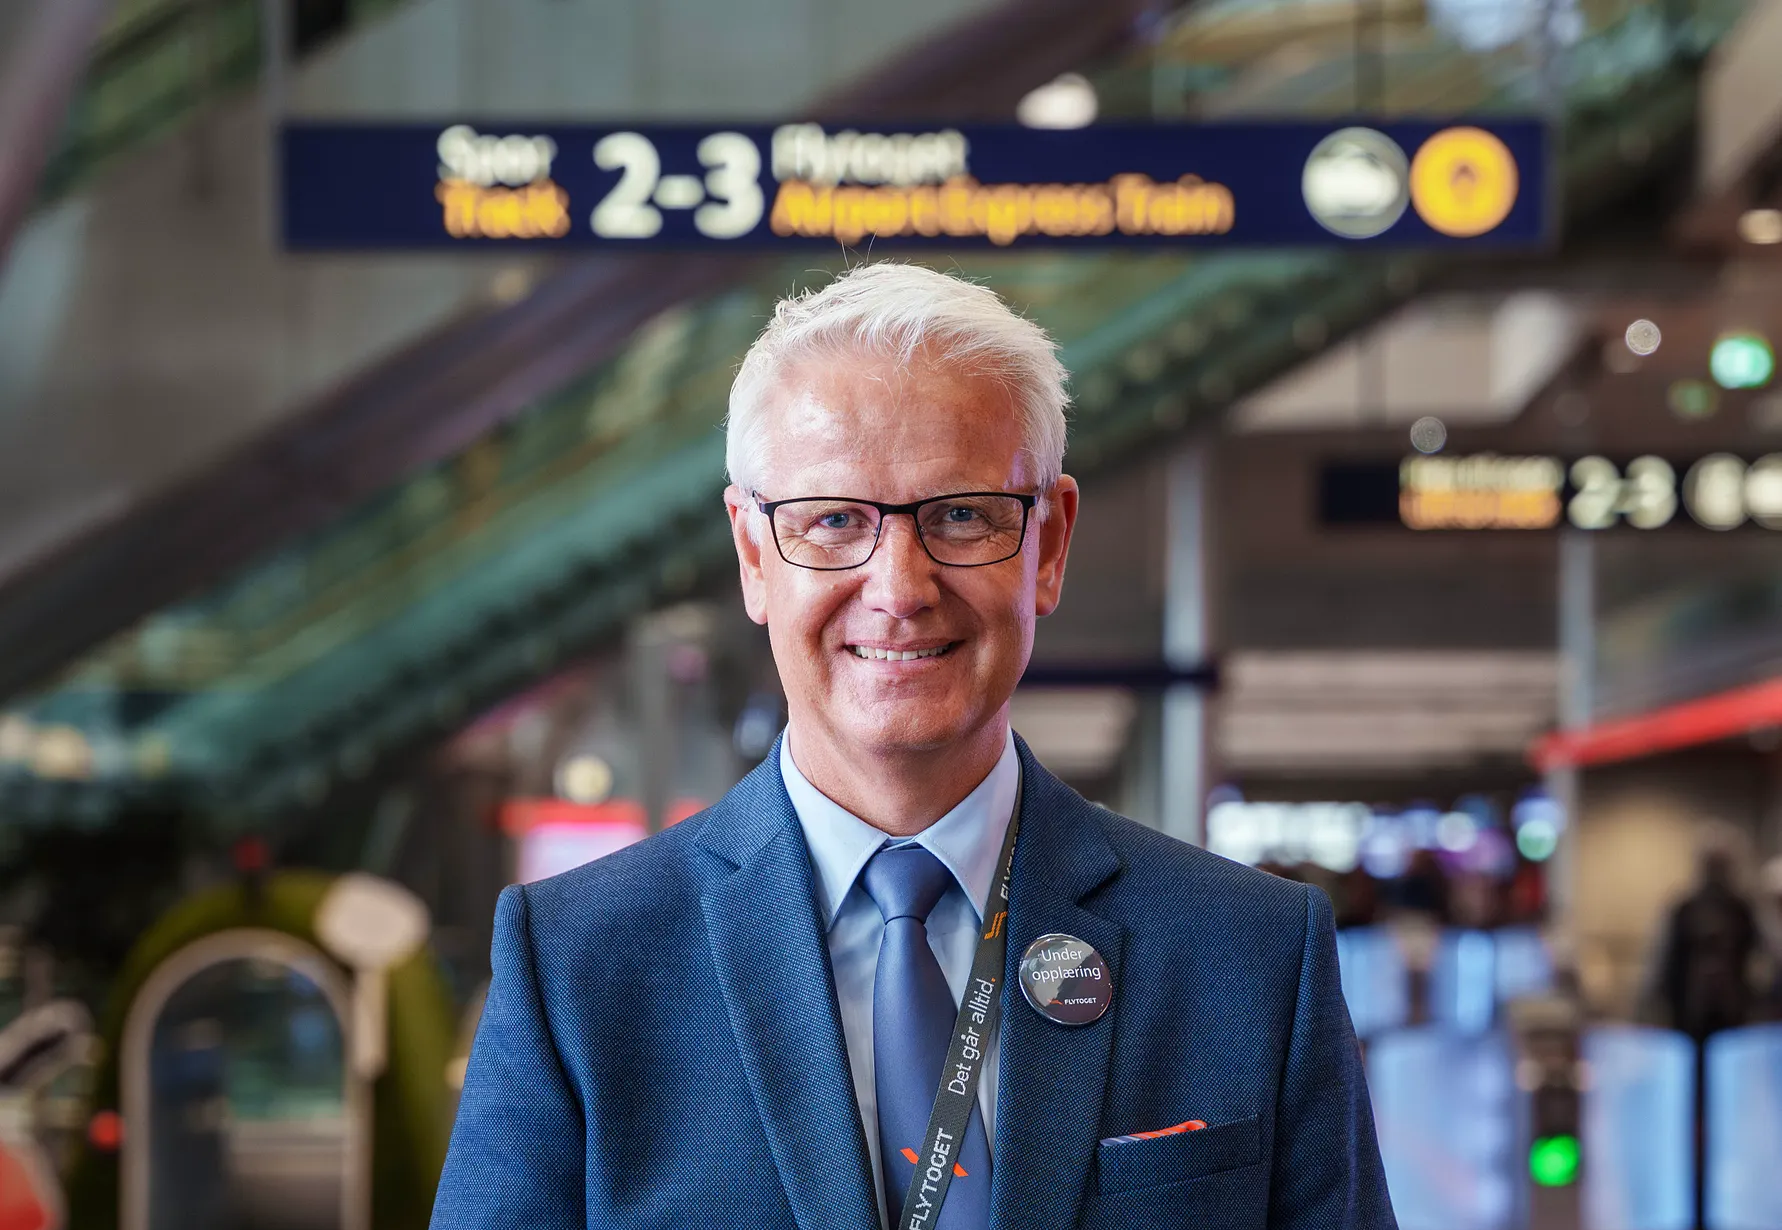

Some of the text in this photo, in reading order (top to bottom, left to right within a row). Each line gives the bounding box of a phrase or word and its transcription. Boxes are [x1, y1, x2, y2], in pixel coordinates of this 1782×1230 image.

[590, 132, 765, 239] 2-3
[1041, 948, 1082, 962] Under
[1032, 965, 1101, 983] opplæring
[1064, 997, 1097, 1005] FLYTOGET
[947, 977, 996, 1096] Det går alltid.
